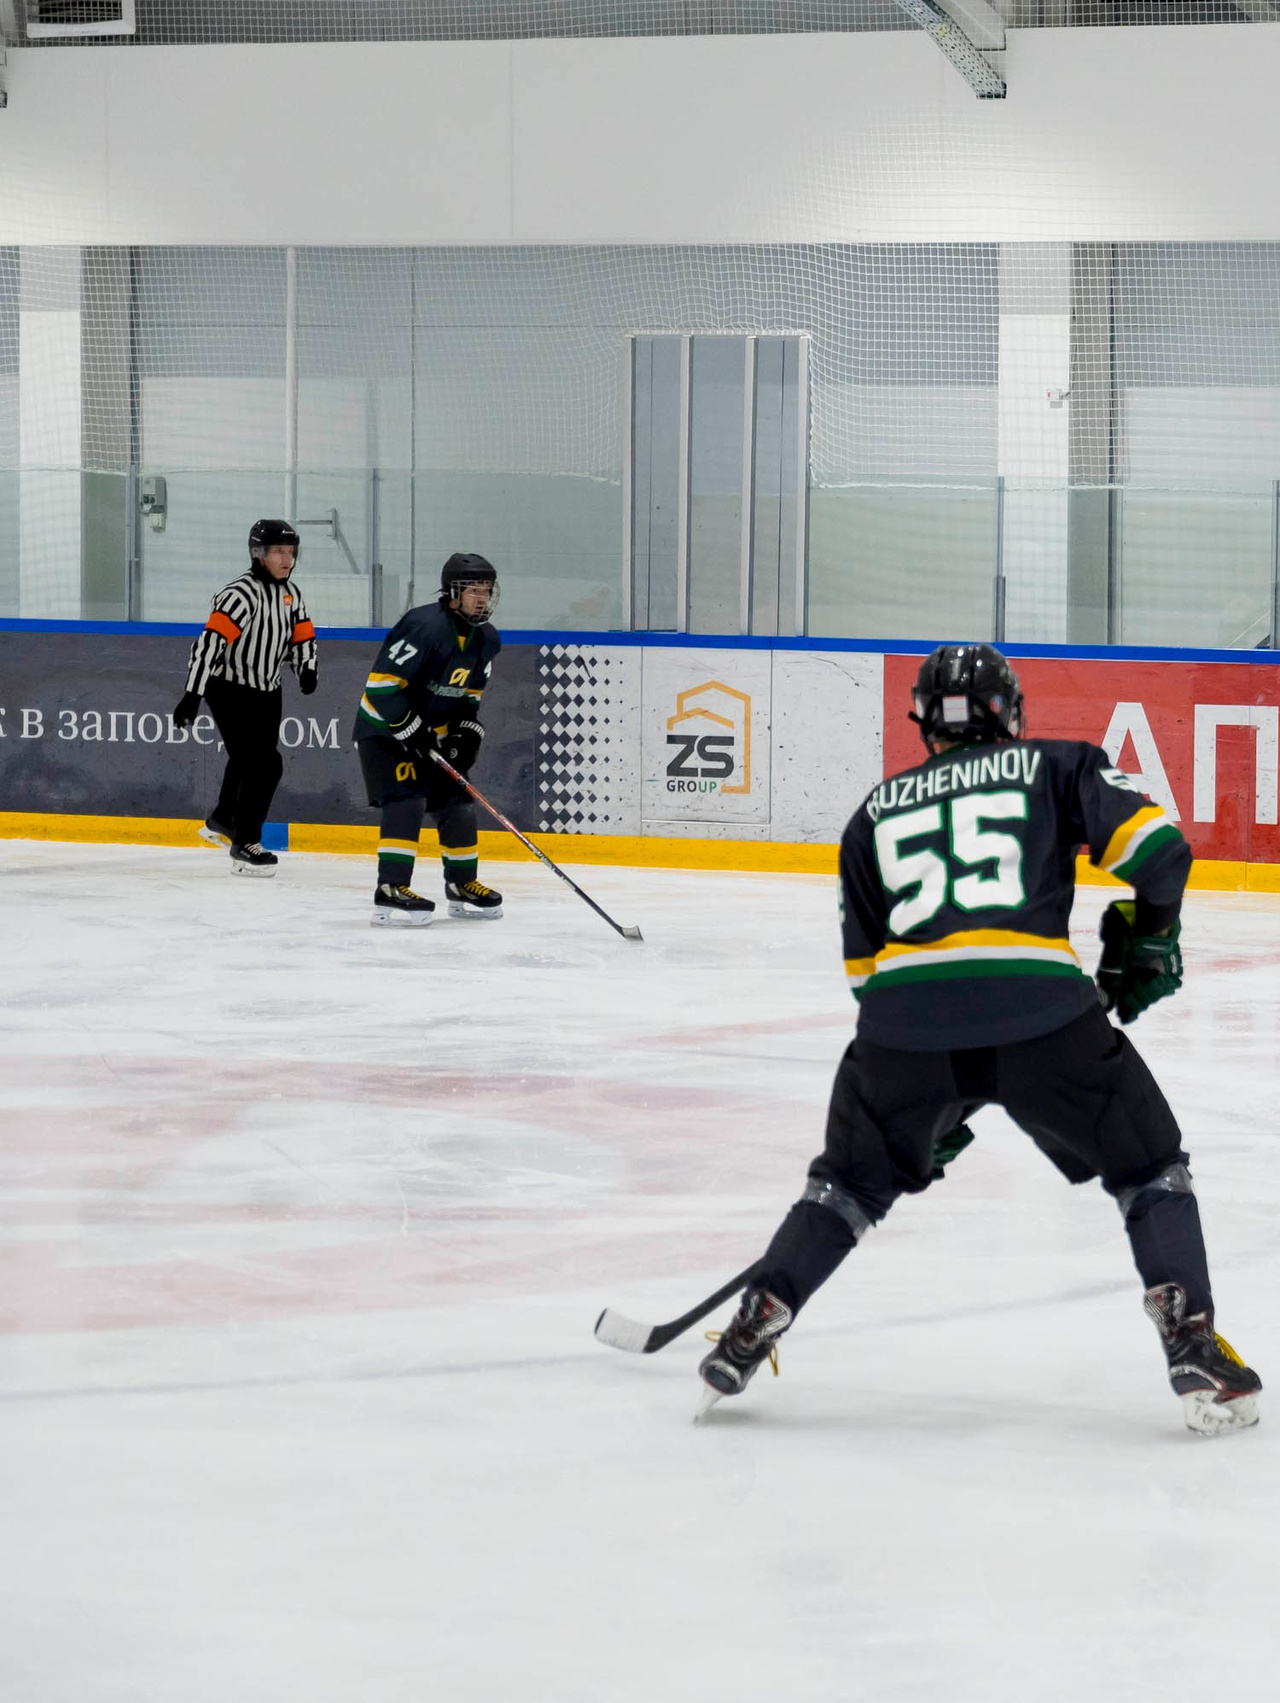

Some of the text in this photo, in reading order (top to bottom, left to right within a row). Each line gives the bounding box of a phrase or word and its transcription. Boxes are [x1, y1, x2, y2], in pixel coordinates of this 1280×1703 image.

[389, 639, 418, 666] 47
[20, 708, 45, 739] в
[58, 709, 341, 752] заповеом
[666, 734, 735, 778] ZS
[666, 779, 718, 793] GROUP
[866, 747, 1041, 823] BUZHENINOV
[874, 789, 1029, 938] 55
